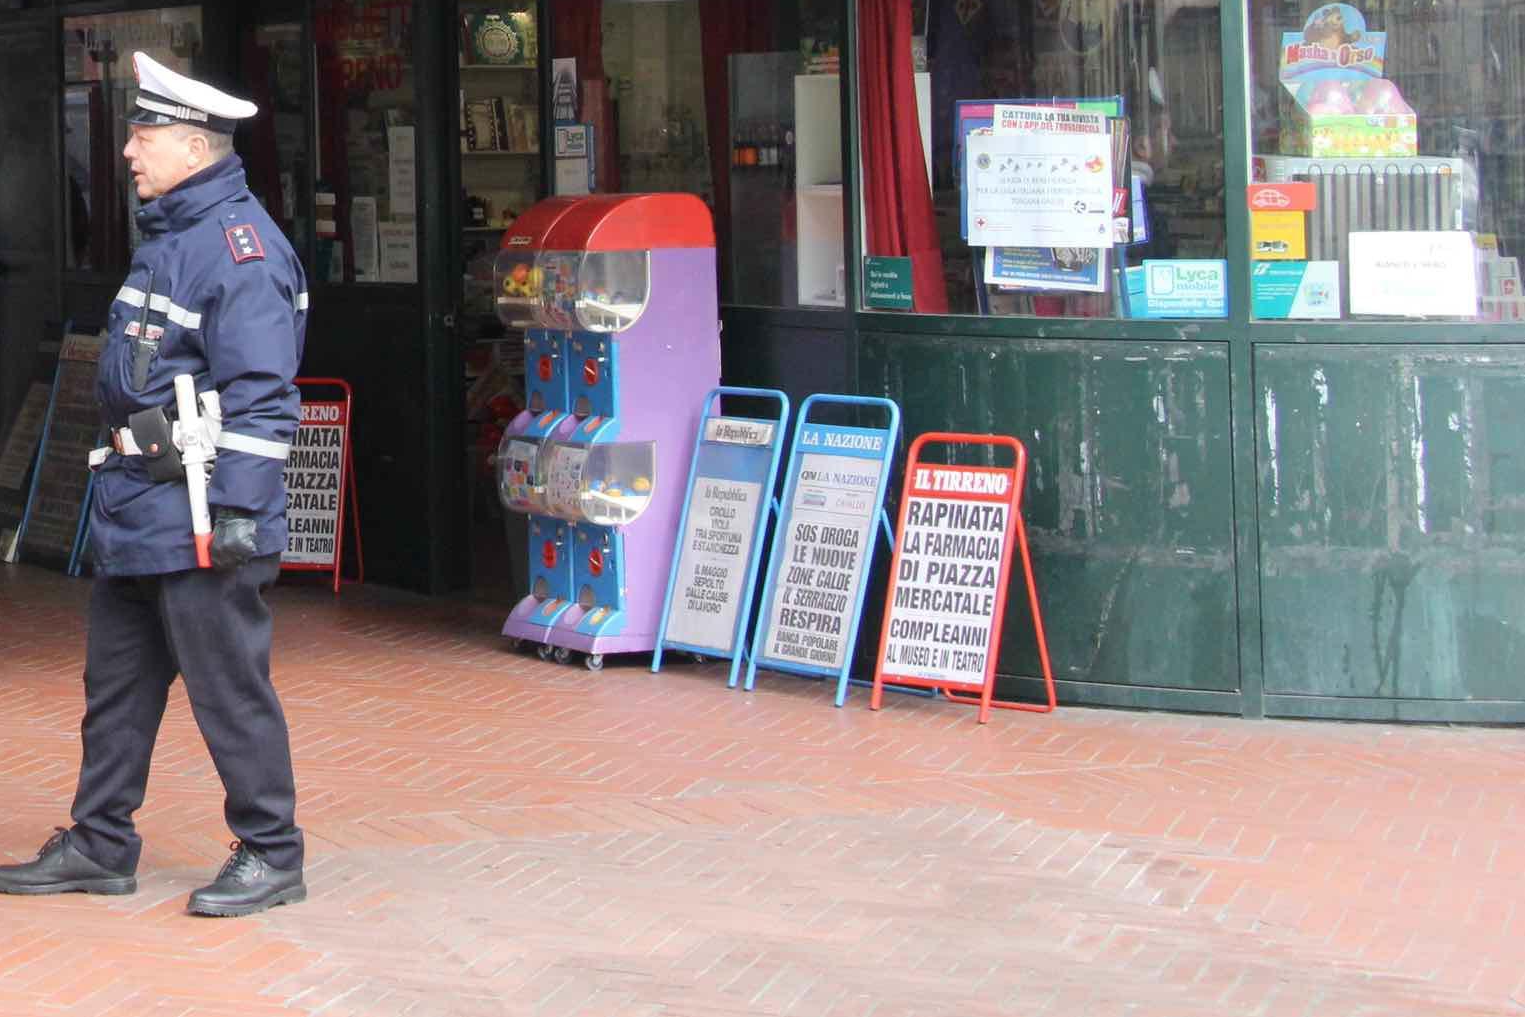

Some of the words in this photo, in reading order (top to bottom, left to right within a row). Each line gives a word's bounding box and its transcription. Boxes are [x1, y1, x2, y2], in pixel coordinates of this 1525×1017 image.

[1339, 44, 1374, 67] Orso
[1002, 110, 1042, 121] CATTURA
[1176, 267, 1218, 282] Lyca
[1176, 280, 1220, 290] mobile
[300, 405, 340, 422] RENO
[723, 425, 759, 441] Repubblica
[802, 431, 819, 445] LA
[823, 432, 883, 451] NAZIONE
[829, 472, 878, 488] NAZIONE
[913, 469, 931, 490] IL
[932, 470, 1009, 495] TIRRENO
[286, 493, 336, 511] CATALE
[907, 500, 1004, 532] RAPINATA
[295, 537, 303, 553] IN
[305, 537, 334, 555] TEATRO
[795, 523, 817, 542] SOS
[820, 526, 860, 548] DROGA
[902, 531, 921, 554] LA
[925, 532, 1000, 562] FARMACIA
[792, 544, 808, 563] LE
[811, 546, 858, 570] NUOVE
[786, 566, 814, 586] ZONE
[816, 570, 852, 591] CALDE
[899, 559, 919, 581] DI
[926, 562, 996, 589] PIAZZA
[782, 586, 793, 604] IL
[794, 588, 847, 613] SERRAGLIO
[894, 586, 994, 616] MERCATALE
[779, 608, 842, 635] RESPIRA
[890, 618, 987, 647] COMPLEANNI
[776, 630, 800, 644] BANCA
[801, 635, 839, 651] POPOLARE
[780, 644, 808, 658] GRANDE
[886, 643, 896, 664] AL
[899, 645, 930, 667] MUSEO
[931, 647, 939, 668] E
[939, 648, 949, 669] IN
[951, 650, 985, 673] TEATRO
